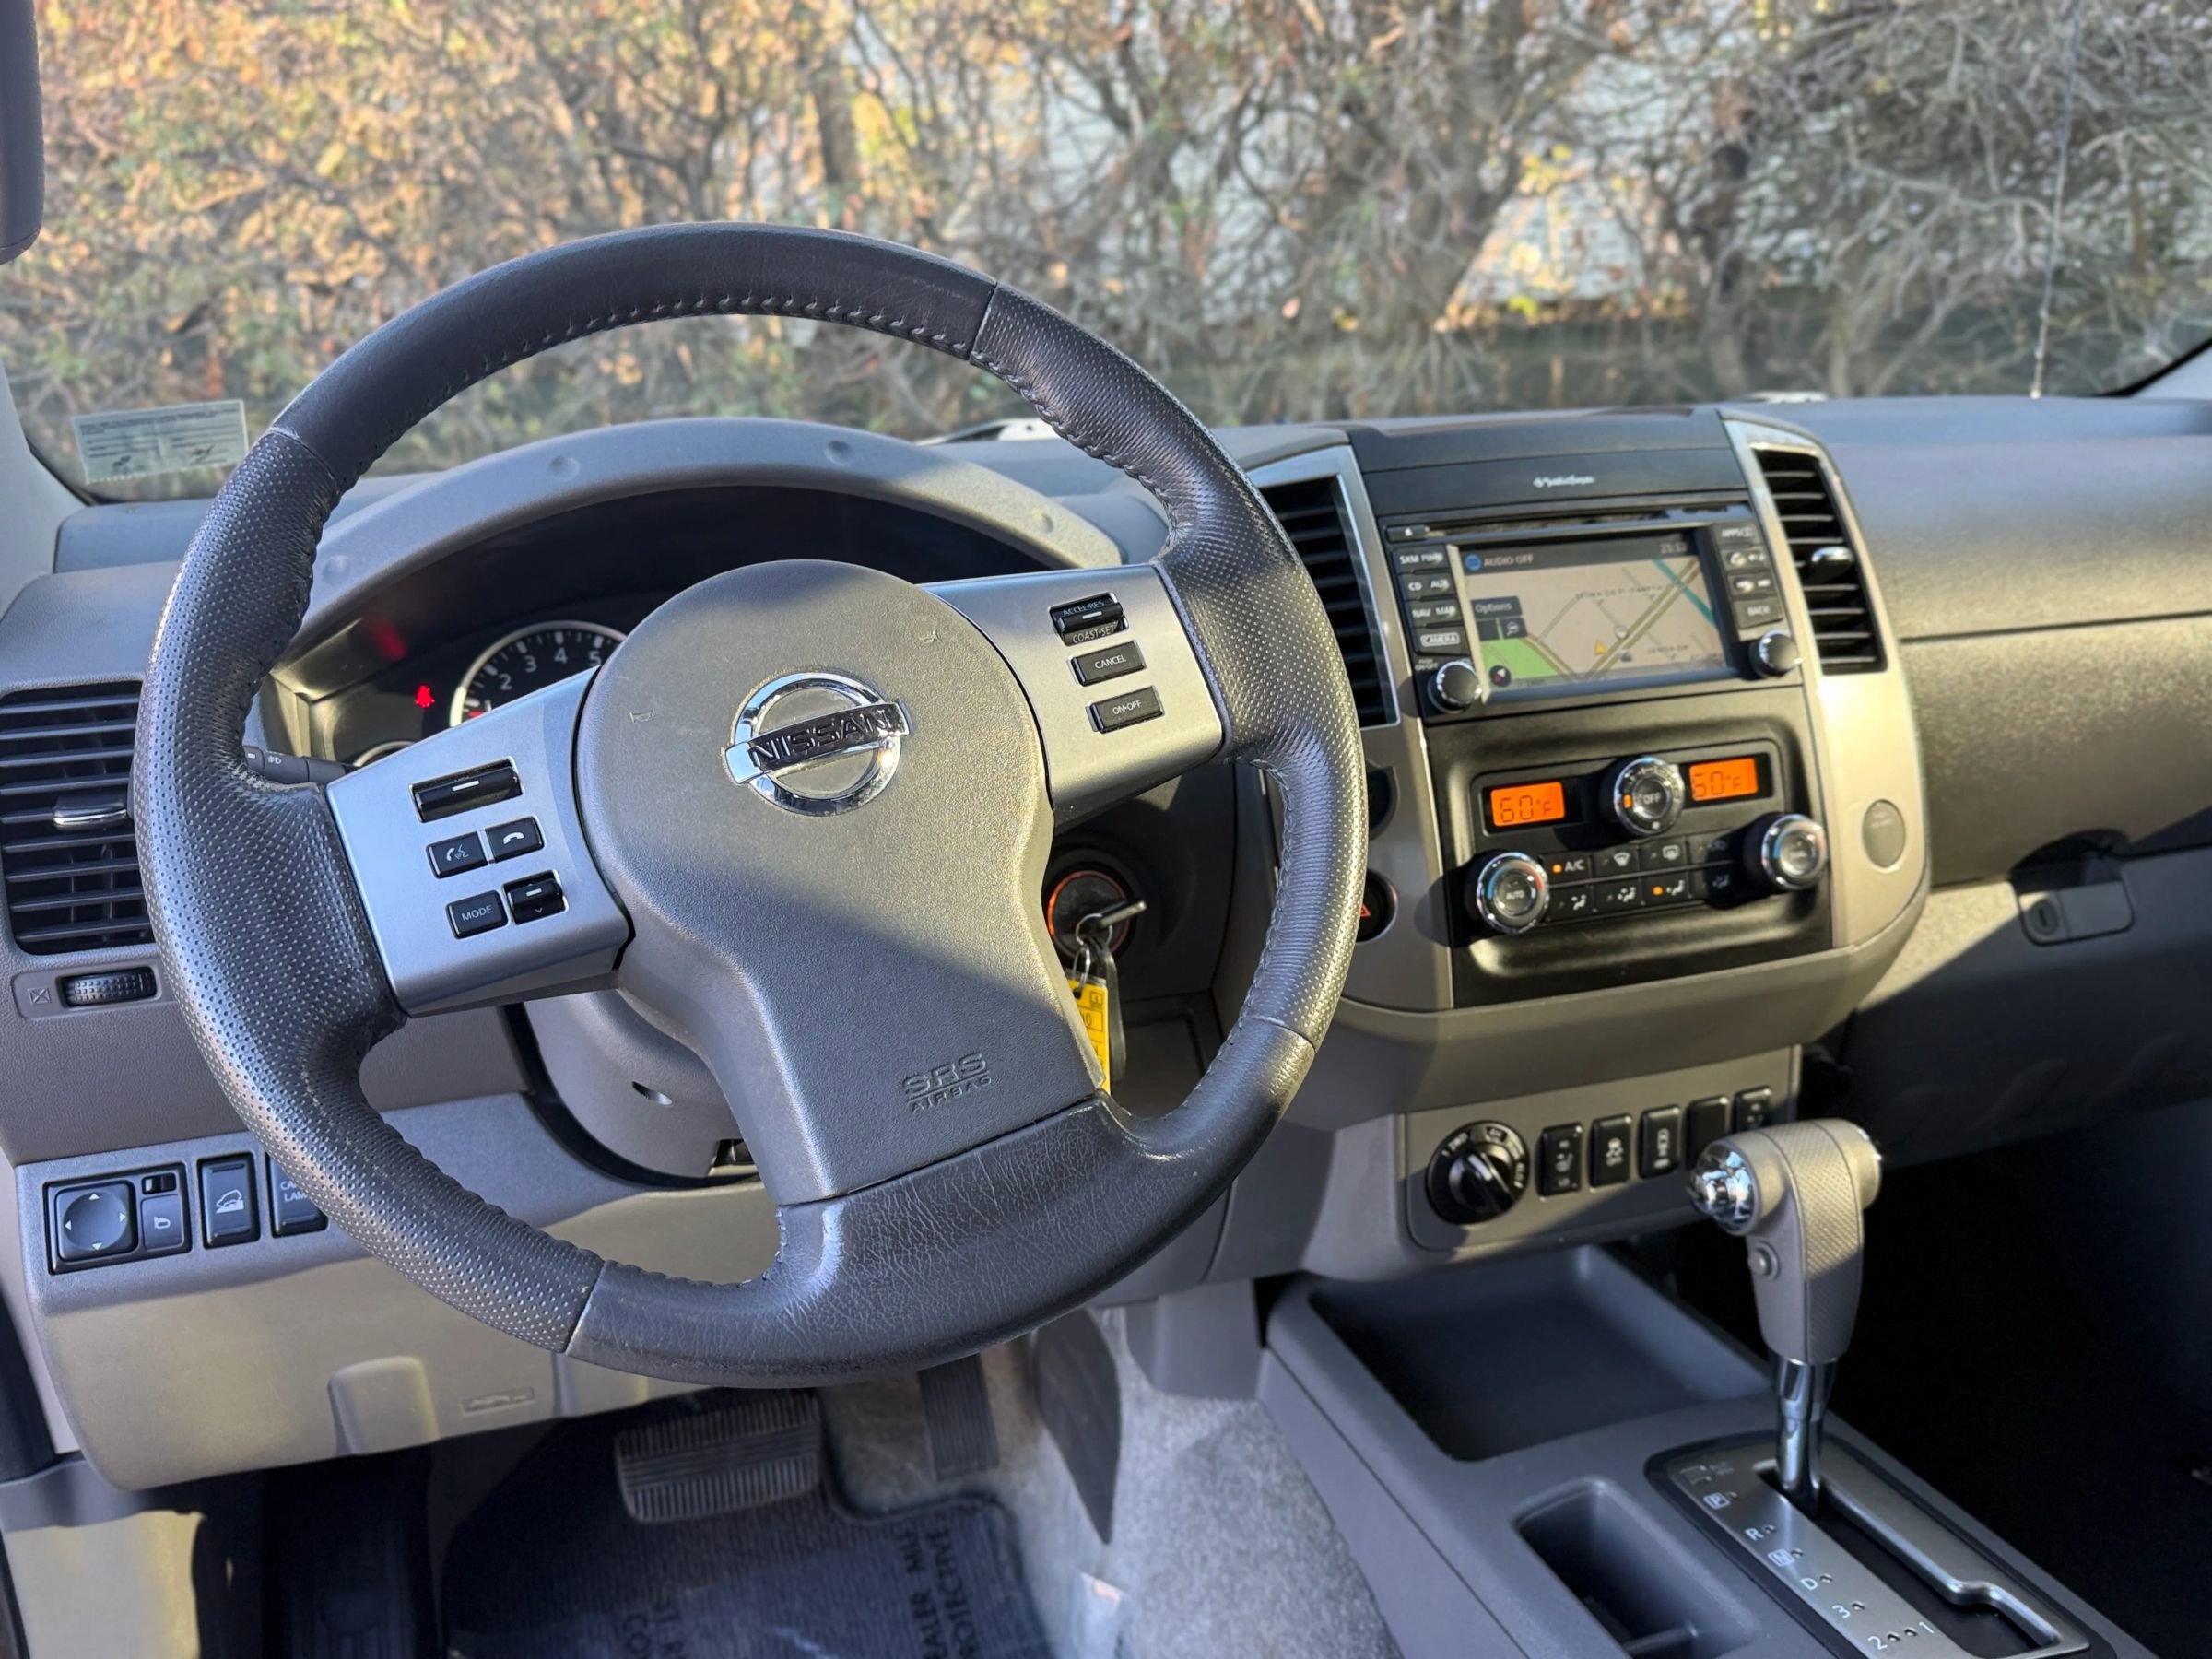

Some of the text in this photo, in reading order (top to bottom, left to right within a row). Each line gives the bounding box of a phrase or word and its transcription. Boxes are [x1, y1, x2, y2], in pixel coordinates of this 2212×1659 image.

[1484, 554, 1534, 567] AUDIO OFF
[1475, 602, 1513, 615] Options
[555, 648, 568, 664] 4
[588, 651, 602, 666] 5
[1094, 654, 1126, 670] CANCEL
[524, 655, 538, 673] 3
[499, 673, 512, 690] 2
[749, 709, 893, 768] NISSAN
[1643, 793, 1662, 805] OFF
[1564, 859, 1584, 872] A/C
[1505, 889, 1525, 900] AUTO
[461, 905, 494, 922] MODE
[901, 1051, 987, 1095] SRS
[911, 1074, 993, 1115] AIRBAG
[1745, 1527, 1765, 1542] R
[1800, 1577, 1819, 1592] D
[1831, 1604, 1852, 1619] 3
[1918, 1620, 1935, 1635] 1
[1867, 1634, 1888, 1651] 2
